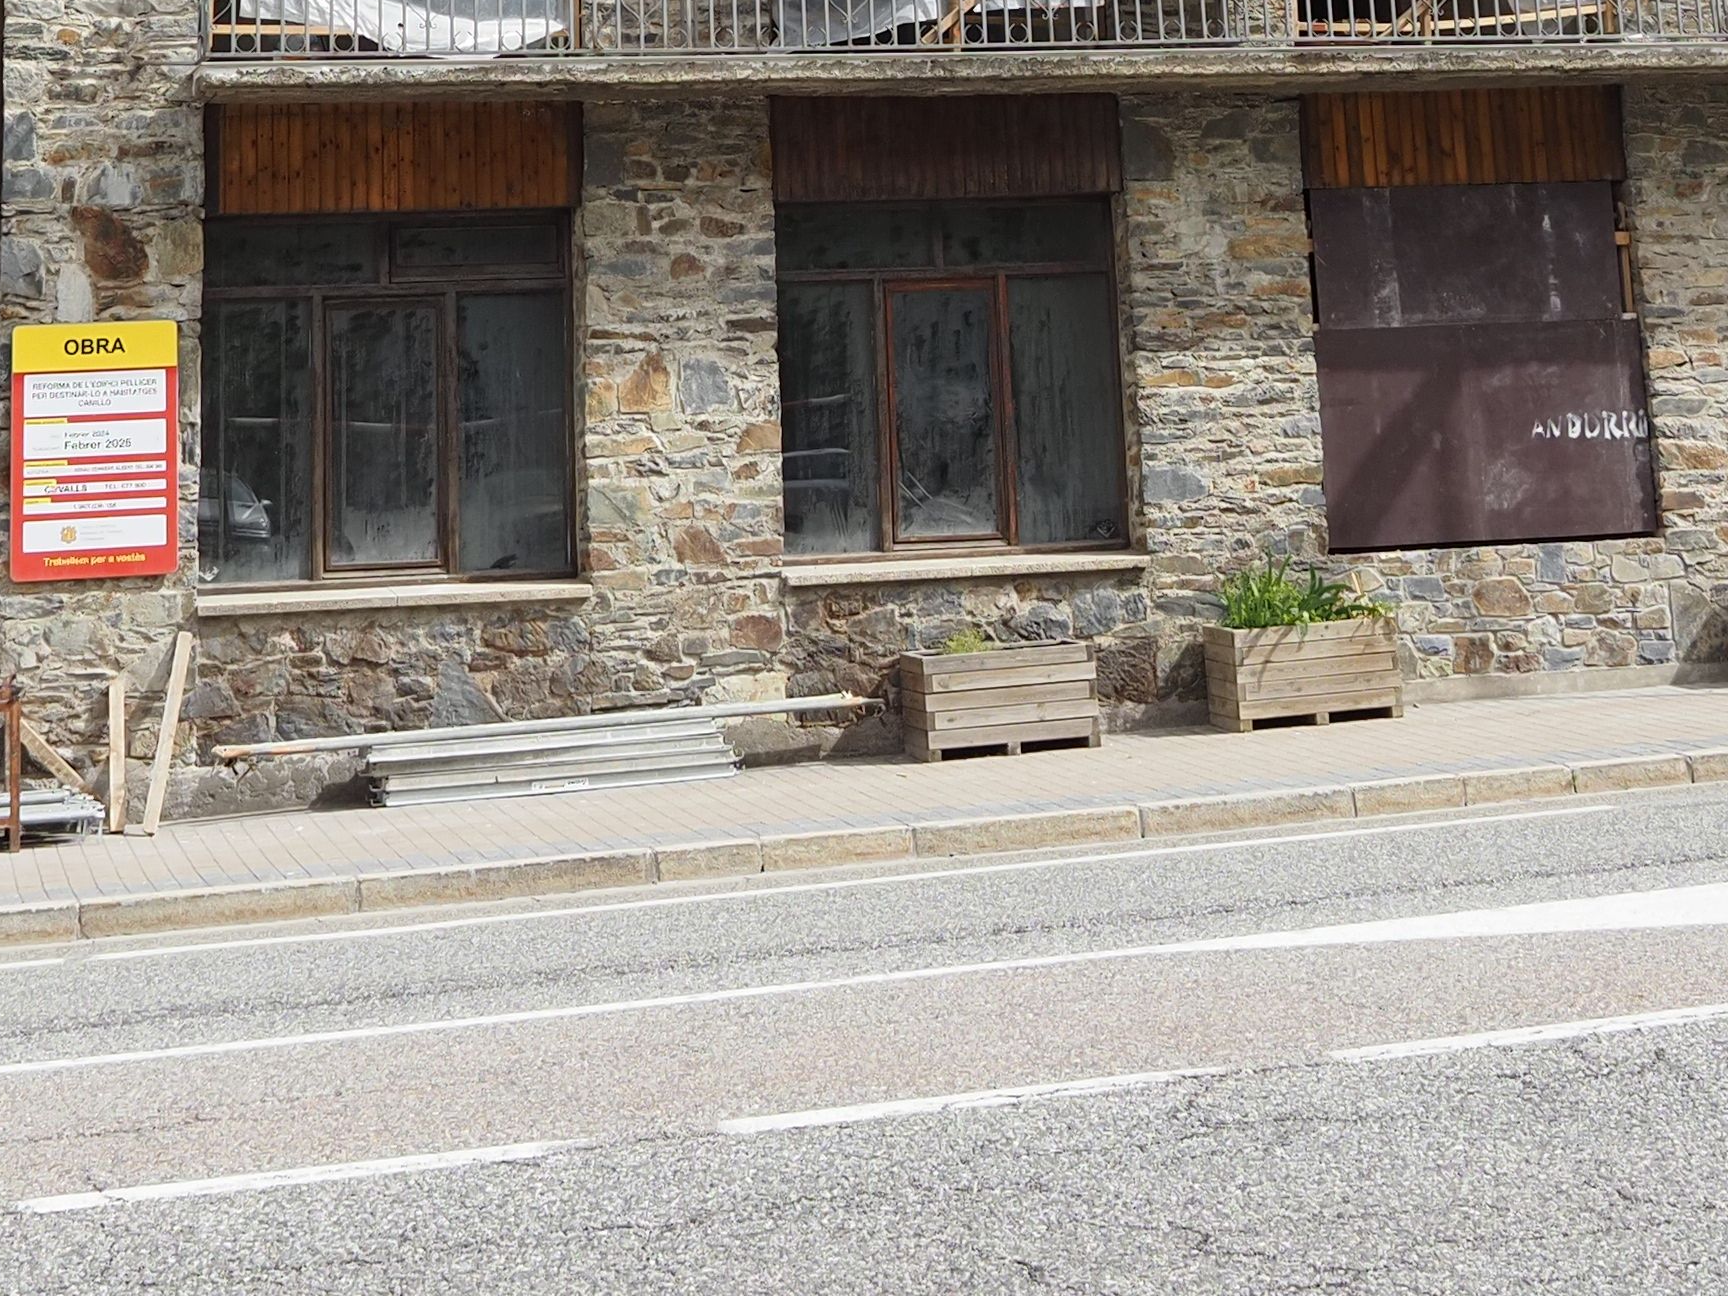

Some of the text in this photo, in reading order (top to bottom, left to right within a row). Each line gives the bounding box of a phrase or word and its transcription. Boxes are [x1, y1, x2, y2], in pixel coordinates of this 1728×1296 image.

[64, 337, 126, 356] OBRA
[32, 381, 70, 391] REFORMA
[72, 380, 83, 389] DE
[120, 377, 158, 387] PELLICER
[78, 398, 112, 407] CANILLO
[64, 439, 101, 451] Febrer
[90, 555, 107, 566] per
